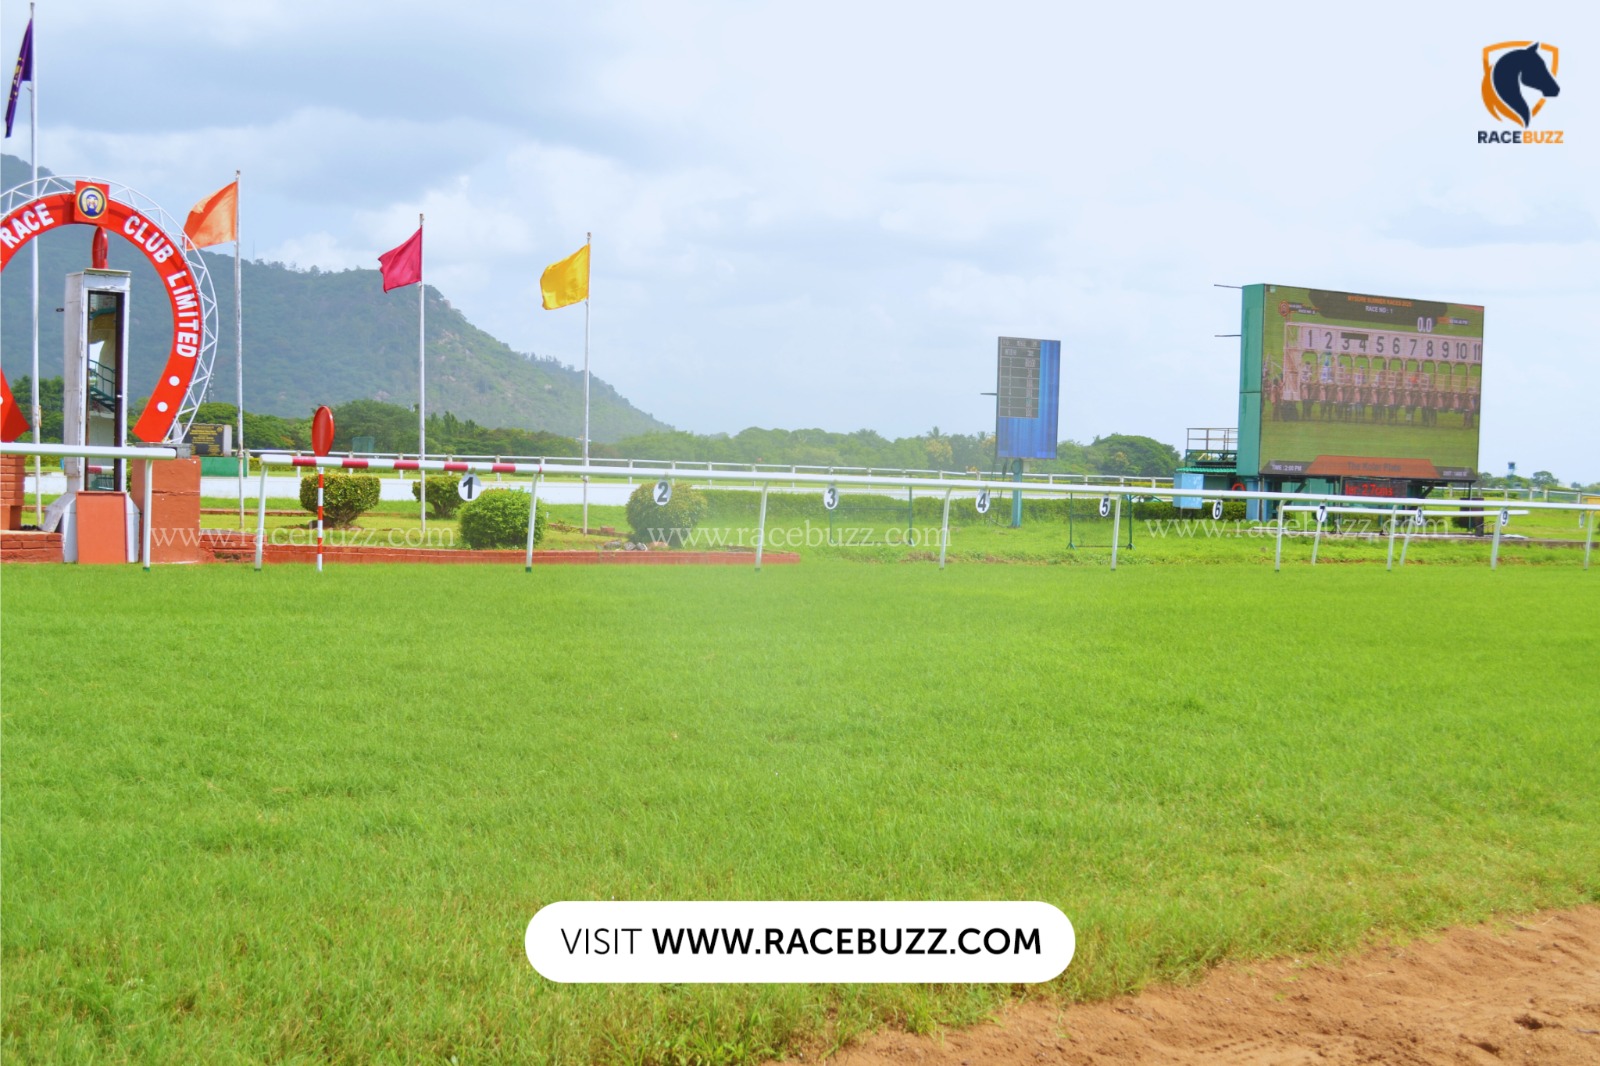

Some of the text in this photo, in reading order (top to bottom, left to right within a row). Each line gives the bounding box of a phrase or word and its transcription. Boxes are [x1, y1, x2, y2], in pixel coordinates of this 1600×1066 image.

[0, 203, 199, 358] RACE CLUB LIMITED
[1417, 316, 1432, 333] 0.0
[1308, 330, 1312, 347] 1
[1325, 332, 1332, 349] 2
[1342, 339, 1350, 350] 3
[1359, 339, 1366, 352] 4
[1376, 336, 1384, 353] 5
[1392, 337, 1400, 354] 6
[1409, 339, 1417, 356] 7
[1426, 340, 1433, 357] 8
[1441, 341, 1449, 358] 9
[1455, 342, 1467, 359] 10
[462, 476, 474, 499] 1
[656, 481, 669, 502] 2
[826, 487, 837, 508] 3
[977, 493, 987, 511] 4
[1101, 498, 1109, 515] 5
[1214, 502, 1221, 518] 6
[1319, 506, 1326, 521] 7
[1416, 508, 1422, 524] 8
[1501, 510, 1508, 525] 9
